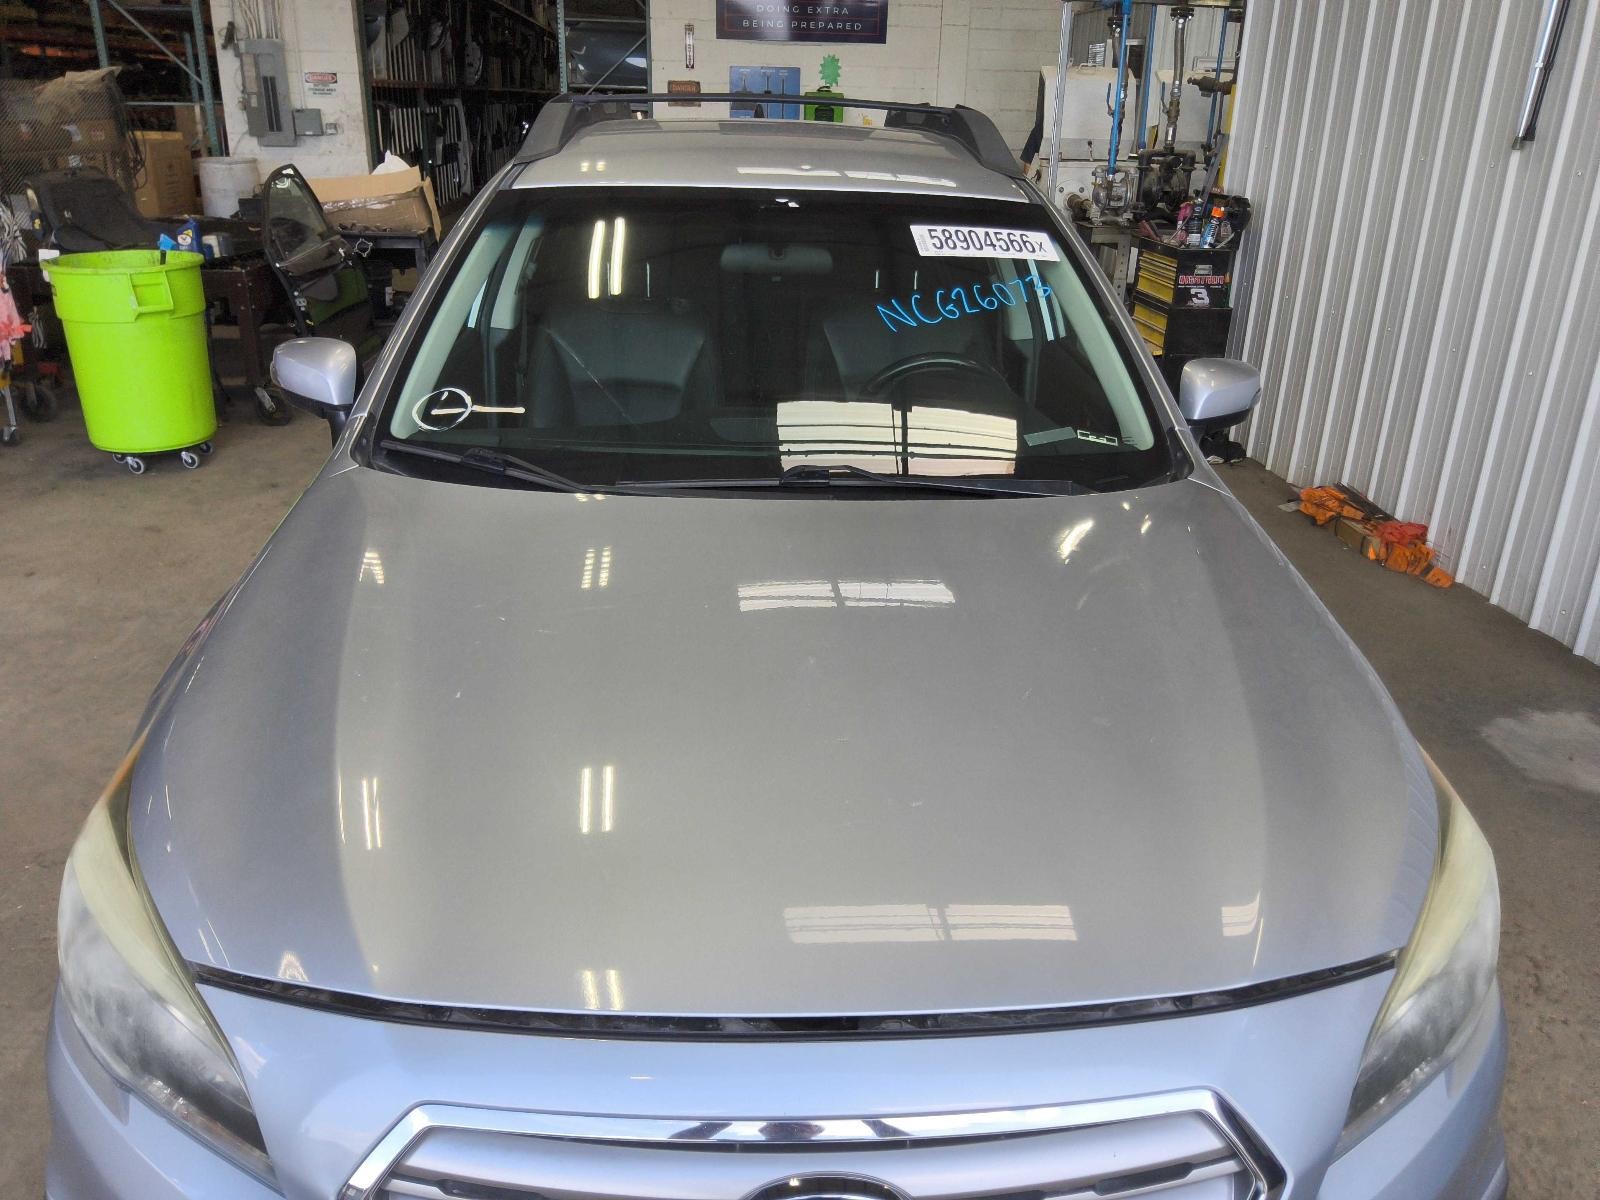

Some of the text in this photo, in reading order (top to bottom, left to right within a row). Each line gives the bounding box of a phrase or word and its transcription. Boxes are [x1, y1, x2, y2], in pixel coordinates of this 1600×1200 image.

[756, 4, 849, 15] DOING EXTRA
[742, 19, 862, 31] BEING PREPARED
